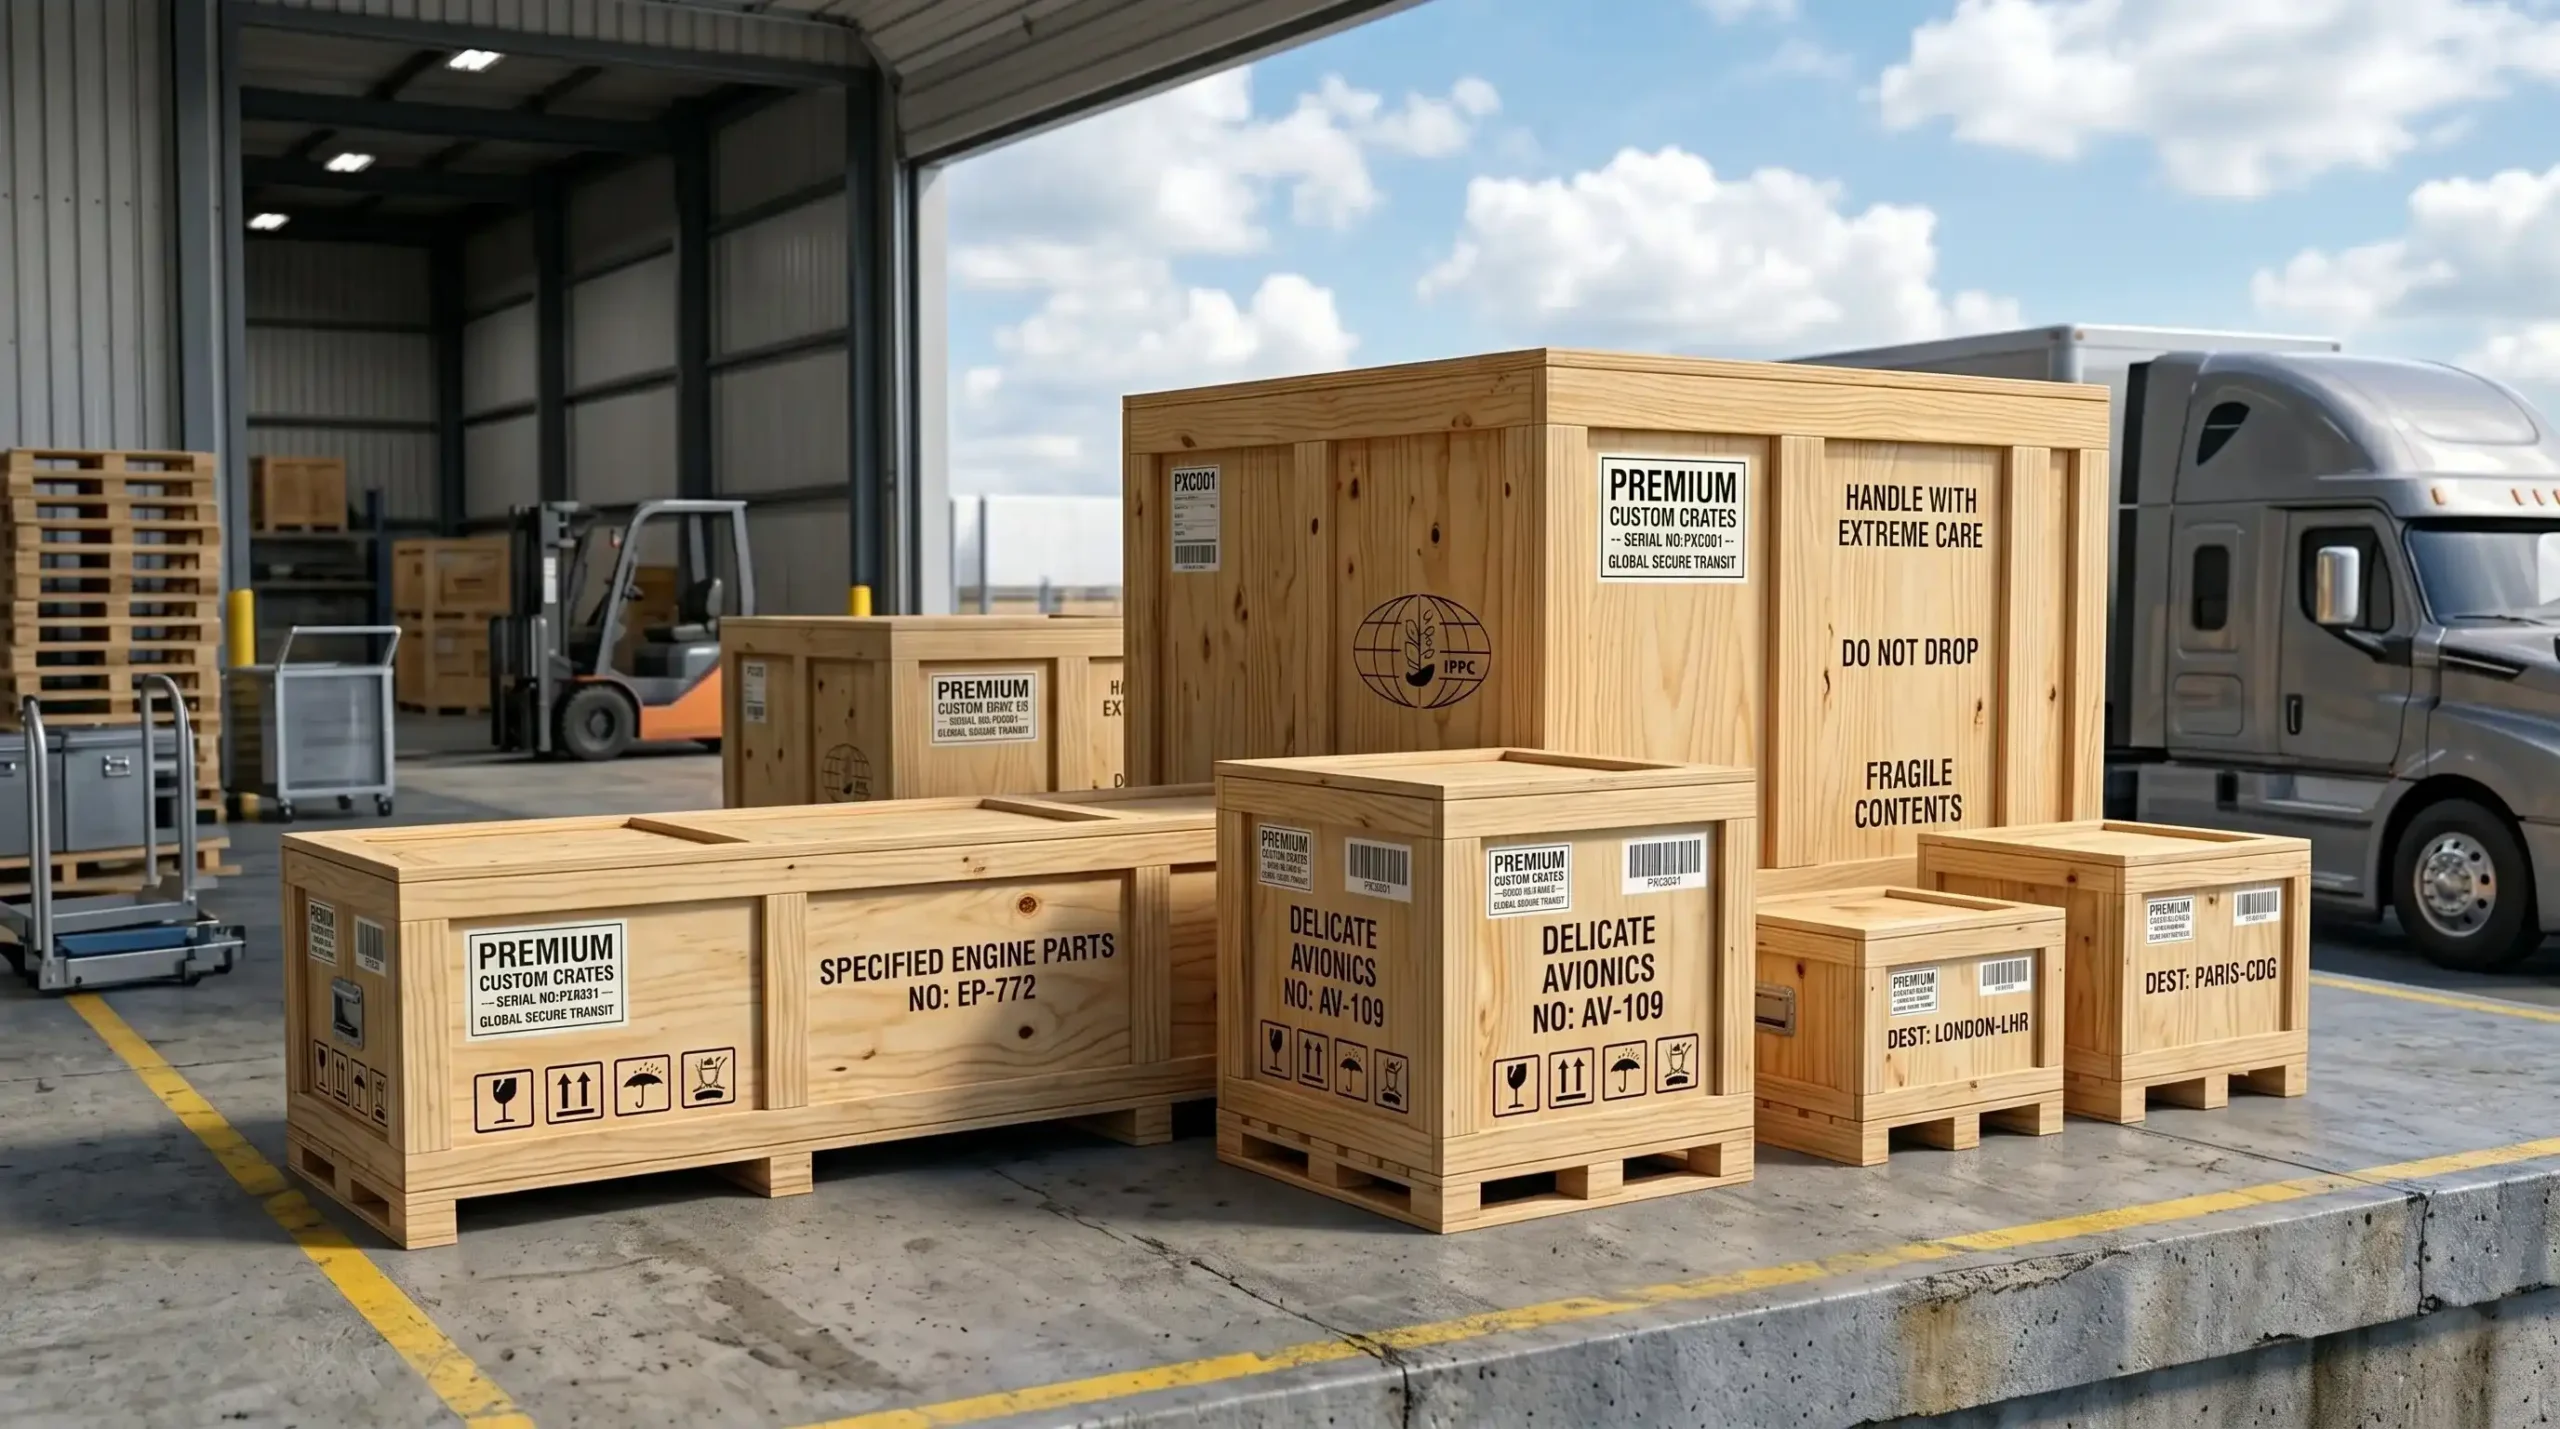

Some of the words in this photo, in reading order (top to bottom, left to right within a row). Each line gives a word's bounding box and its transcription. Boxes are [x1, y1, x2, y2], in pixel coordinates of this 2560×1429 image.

[1174, 471, 1215, 492] PXC001
[1610, 468, 1736, 503] PREMIUM
[1846, 484, 1923, 512] HANDLE
[1929, 486, 1977, 514] WITH
[1610, 506, 1674, 526] CUSTOM
[1680, 508, 1736, 528] CRATES
[1624, 532, 1662, 547] SERIAL
[1838, 519, 1928, 548] EXTREME
[1936, 522, 1983, 548] CARE
[1608, 554, 1649, 569] GLOBAL
[1652, 555, 1692, 569] SECURE
[1694, 555, 1736, 569] TRANSIT
[1842, 638, 1870, 667] DO
[1878, 638, 1918, 666] NOT
[1925, 638, 1978, 666] DROP
[1444, 660, 1476, 675] IPPC
[938, 679, 1028, 700] PREMIUM
[938, 702, 982, 714] CUSTOM
[1866, 758, 1953, 790] FRAGILE
[1854, 794, 1962, 828] CONTENTS
[1262, 830, 1308, 854] PREMIUM
[1494, 850, 1564, 874] PREMIUM
[1494, 874, 1530, 886] CUSTOM
[1532, 870, 1564, 883] CRATES
[2150, 901, 2190, 916] PREMIUM
[1290, 904, 1376, 950] DELICATE
[1543, 915, 1656, 955] DELICATE
[479, 933, 613, 970] PREMIUM
[820, 948, 944, 985] SPECIFIED
[952, 940, 1036, 972] ENGINE
[1043, 932, 1115, 964] PARTS
[1291, 942, 1376, 988] AVIONICS
[480, 970, 548, 992] CUSTOM
[553, 964, 614, 985] CRATES
[1542, 953, 1655, 994] AVIONICS
[1893, 972, 1934, 989] PREMIUM
[2146, 968, 2190, 995] DEST:
[2196, 957, 2276, 988] PARIS-CDG
[496, 994, 536, 1008] SERIAL
[909, 984, 949, 1012] NO:
[958, 974, 1036, 1007] EP-772
[1284, 977, 1313, 1012] NO:
[1319, 986, 1384, 1028] AV-109
[480, 1013, 522, 1028] GLOBAL
[525, 1008, 567, 1023] SECURE
[569, 1004, 614, 1018] TRANSIT
[1533, 1000, 1574, 1034] NO:
[1582, 990, 1663, 1028] AV-109
[1888, 1025, 1930, 1049] DEST:
[1936, 1012, 2029, 1042] LONDON-LHR
